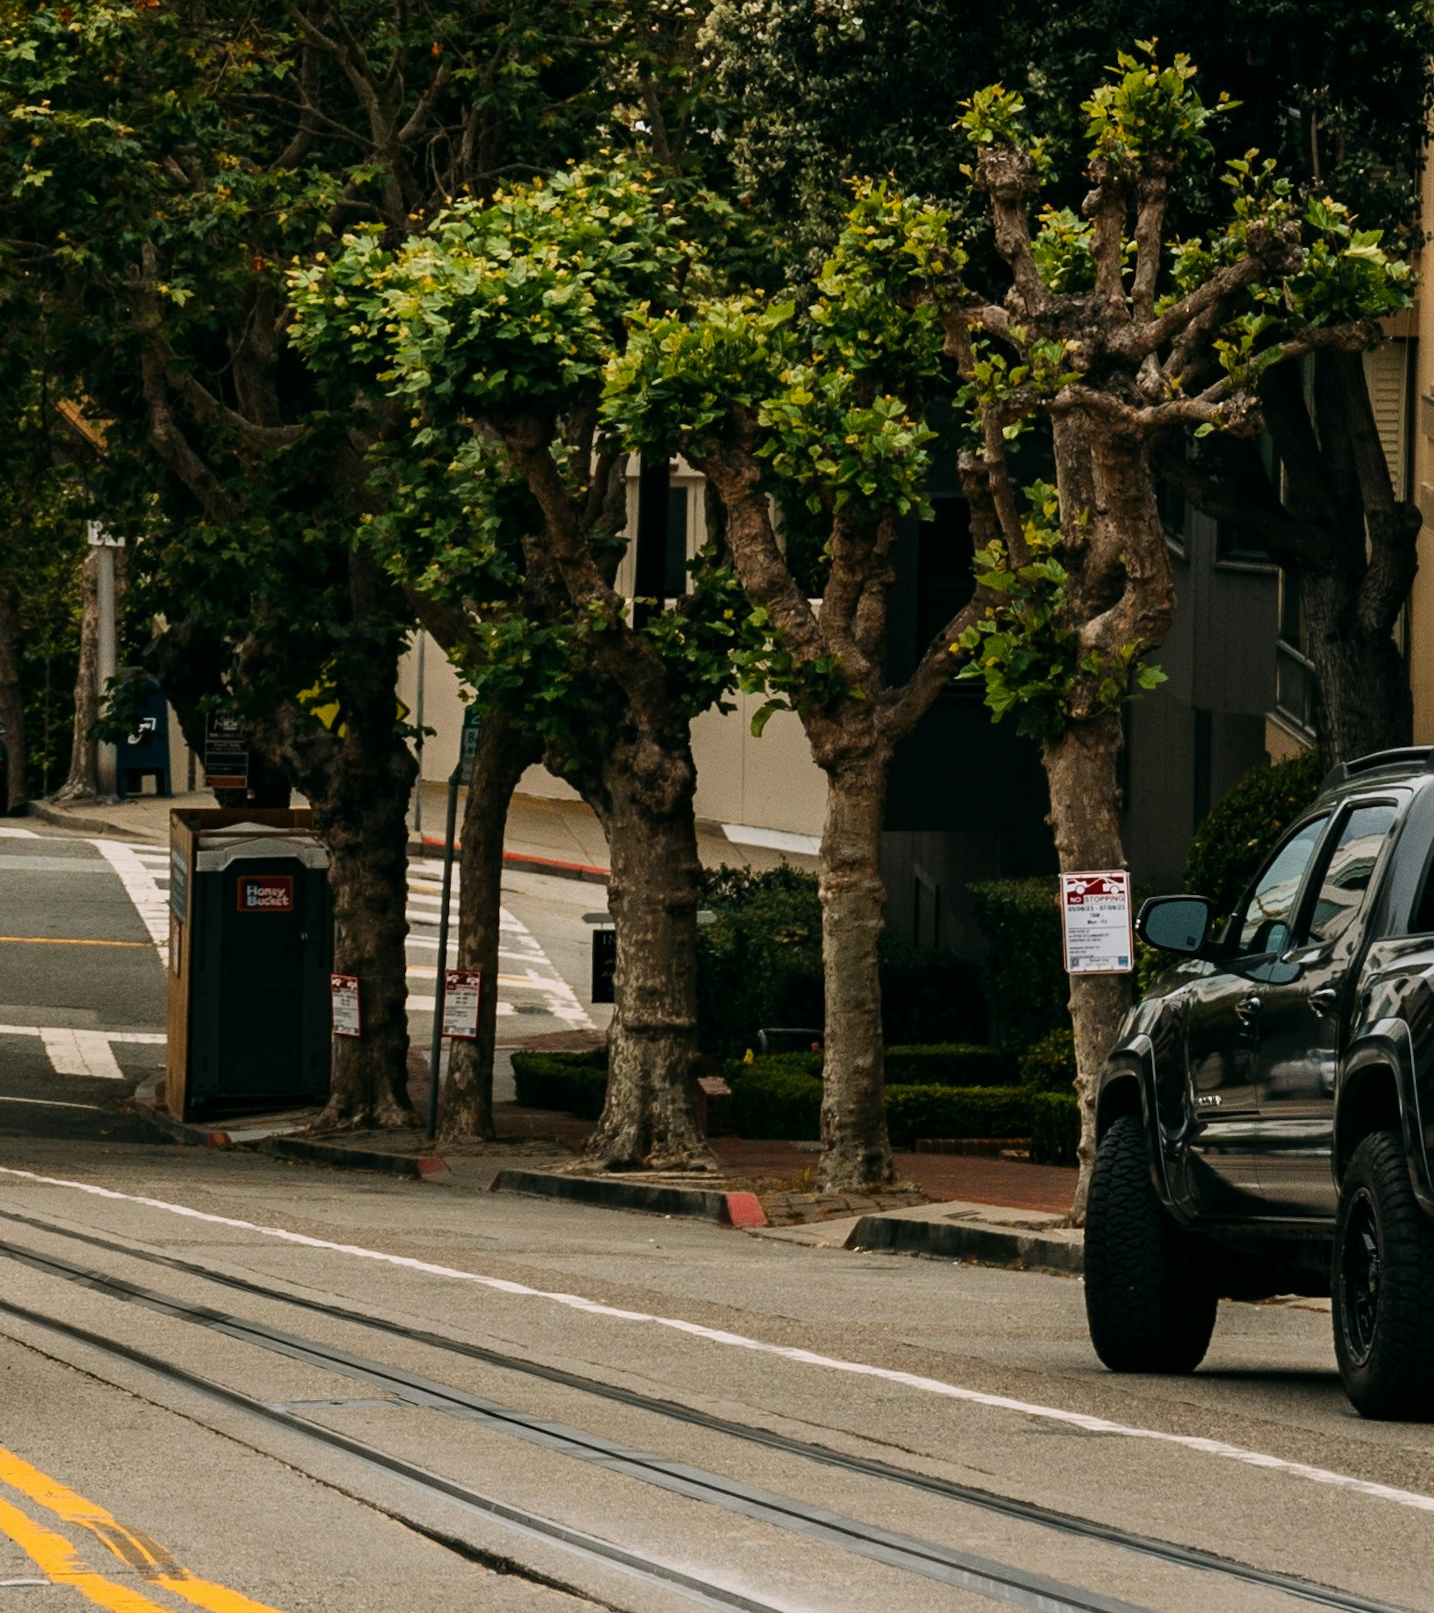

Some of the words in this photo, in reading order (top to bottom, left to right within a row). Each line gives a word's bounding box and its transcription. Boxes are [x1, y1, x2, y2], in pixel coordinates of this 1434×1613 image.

[246, 885, 286, 898] Honey
[246, 895, 290, 906] Bucket
[1085, 895, 1125, 903] STOPPING
